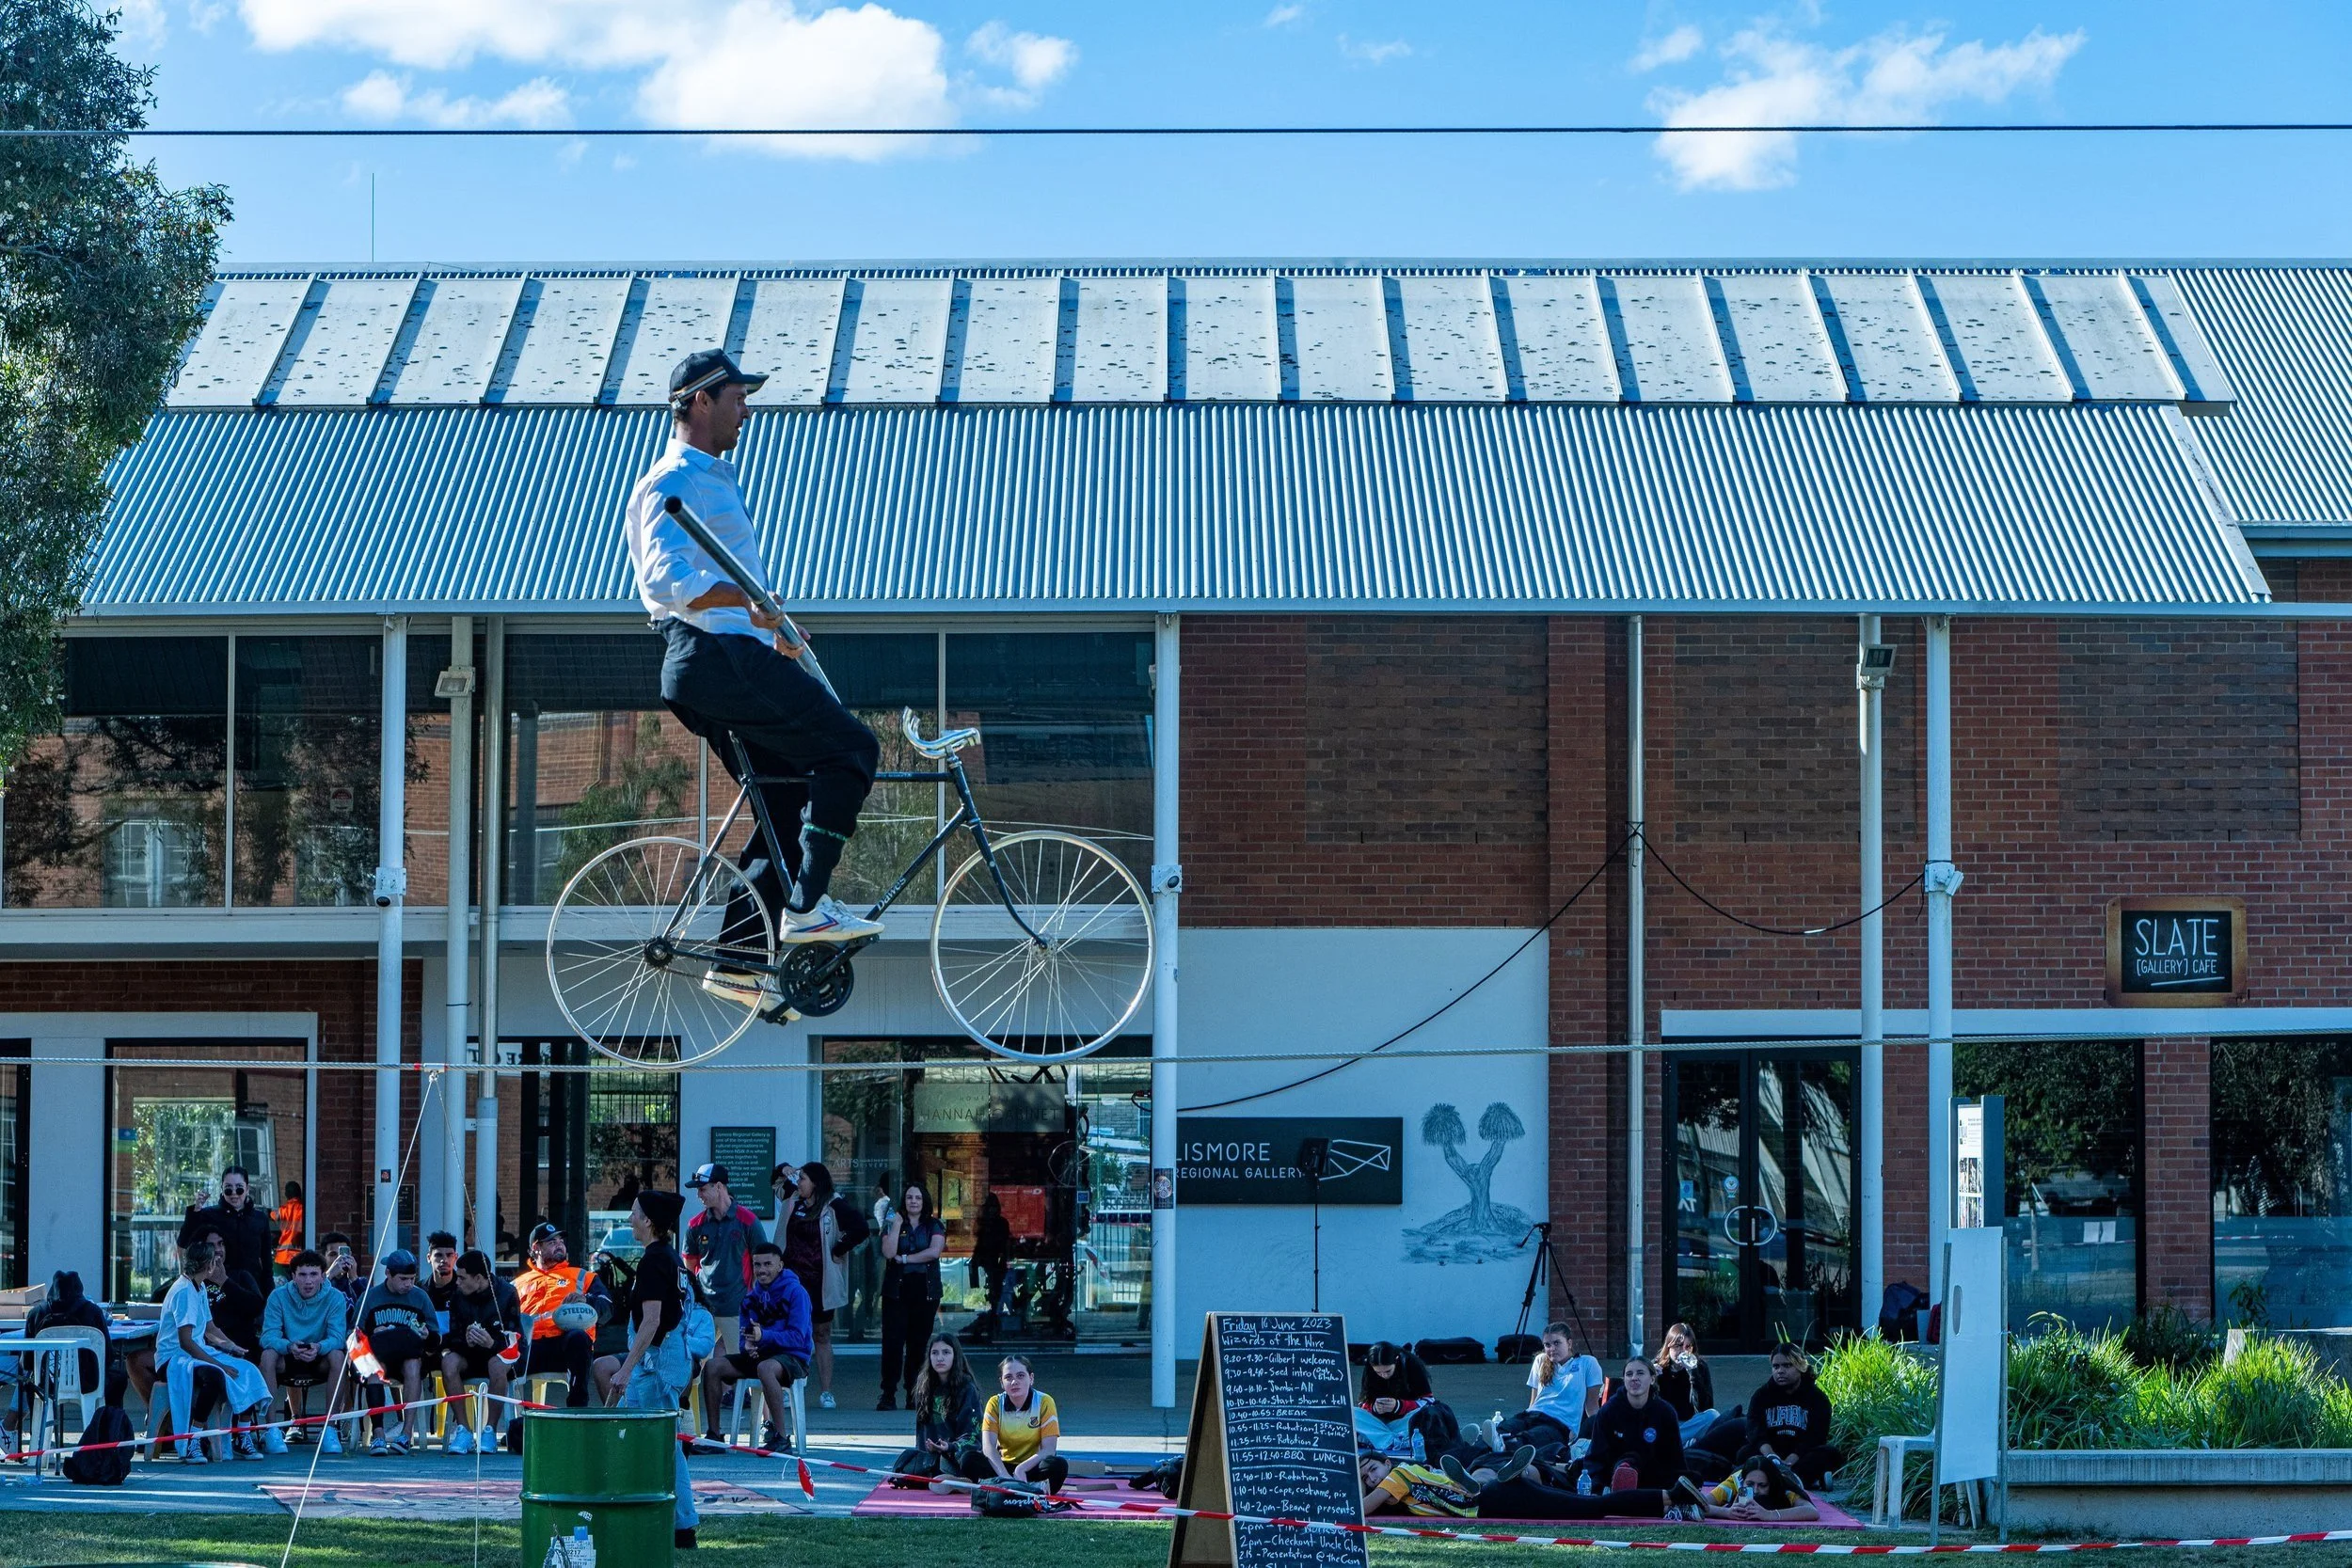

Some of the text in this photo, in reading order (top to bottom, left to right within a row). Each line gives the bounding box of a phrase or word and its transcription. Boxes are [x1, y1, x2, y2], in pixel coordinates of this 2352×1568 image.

[877, 878, 906, 911] Dawes
[2136, 918, 2218, 956] SLATE
[2193, 959, 2217, 974] CAFE
[921, 1108, 984, 1121] HANNAH
[834, 1158, 859, 1168] ARTS
[1246, 1167, 1304, 1179] GALLERY
[374, 1307, 418, 1326] HOODRICH
[563, 1307, 594, 1316] STEEDEN
[1223, 1317, 1332, 1337] Friday 16 June 2023
[1222, 1335, 1265, 1346] Wizards
[1269, 1333, 1280, 1345] of
[1305, 1334, 1325, 1348] Wire
[1300, 1354, 1336, 1365] welcome
[1298, 1395, 1318, 1405] show
[1331, 1394, 1347, 1405] tell
[1313, 1452, 1345, 1465] LUNCH
[1320, 1472, 1328, 1482] 3
[1334, 1490, 1346, 1498] pix
[1317, 1500, 1355, 1515] presents
[1320, 1536, 1342, 1549] Uncle
[1344, 1539, 1363, 1554] Glen
